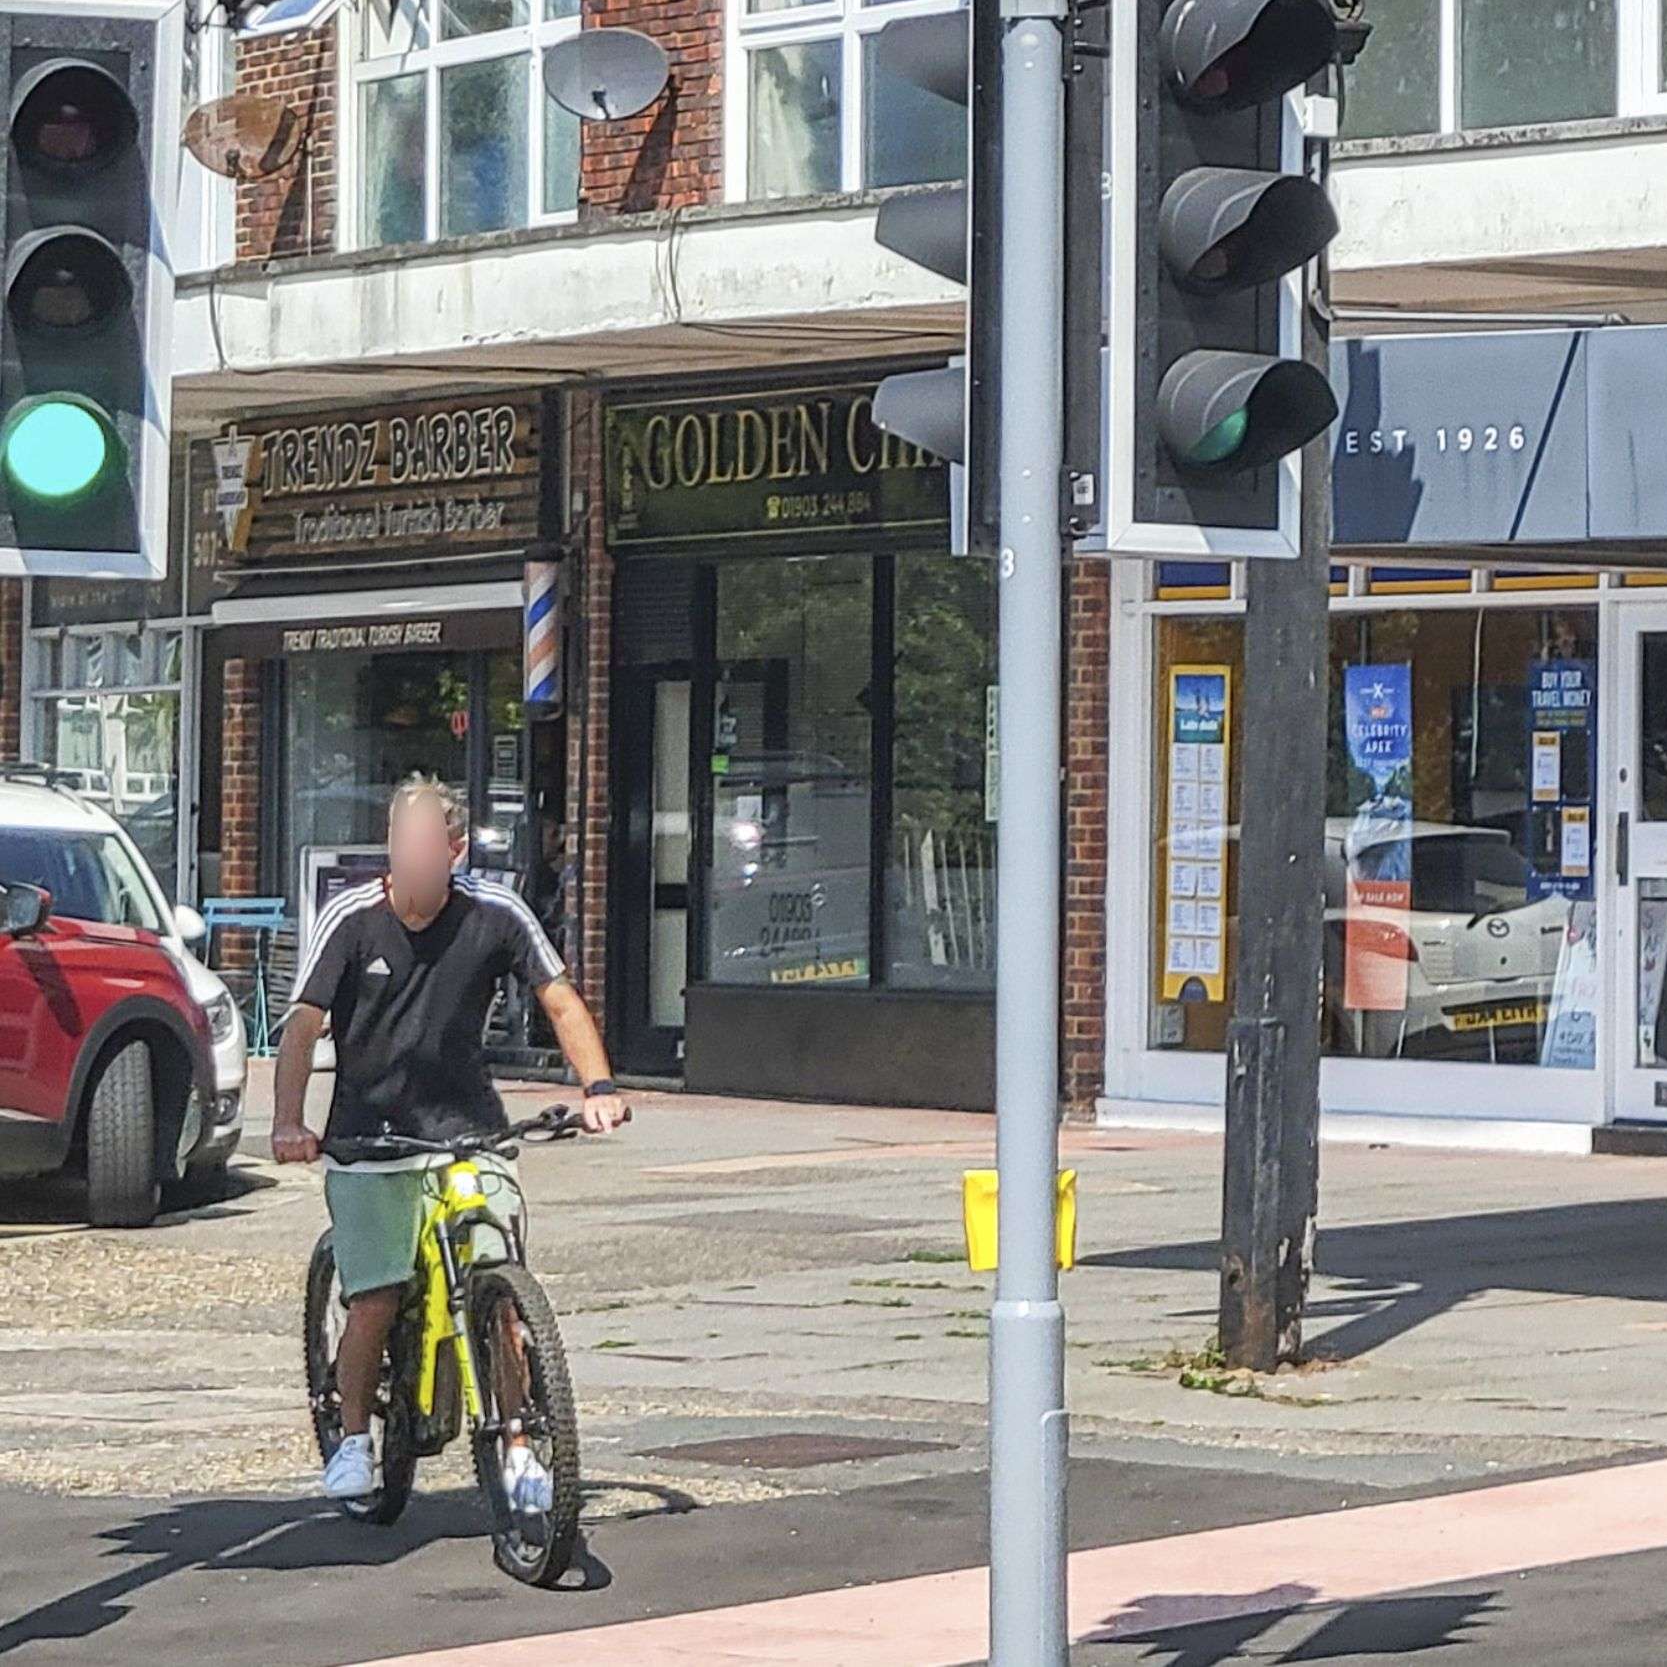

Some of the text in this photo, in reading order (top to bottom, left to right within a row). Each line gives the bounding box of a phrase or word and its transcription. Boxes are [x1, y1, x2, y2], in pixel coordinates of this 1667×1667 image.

[261, 406, 518, 497] TRENDZ BARBER
[642, 401, 833, 491] GOLDEN
[1345, 424, 1527, 455] EST 1926
[292, 502, 381, 544] Traditional
[443, 495, 506, 532] Barber
[1532, 689, 1591, 708] TRAVEL MONEY
